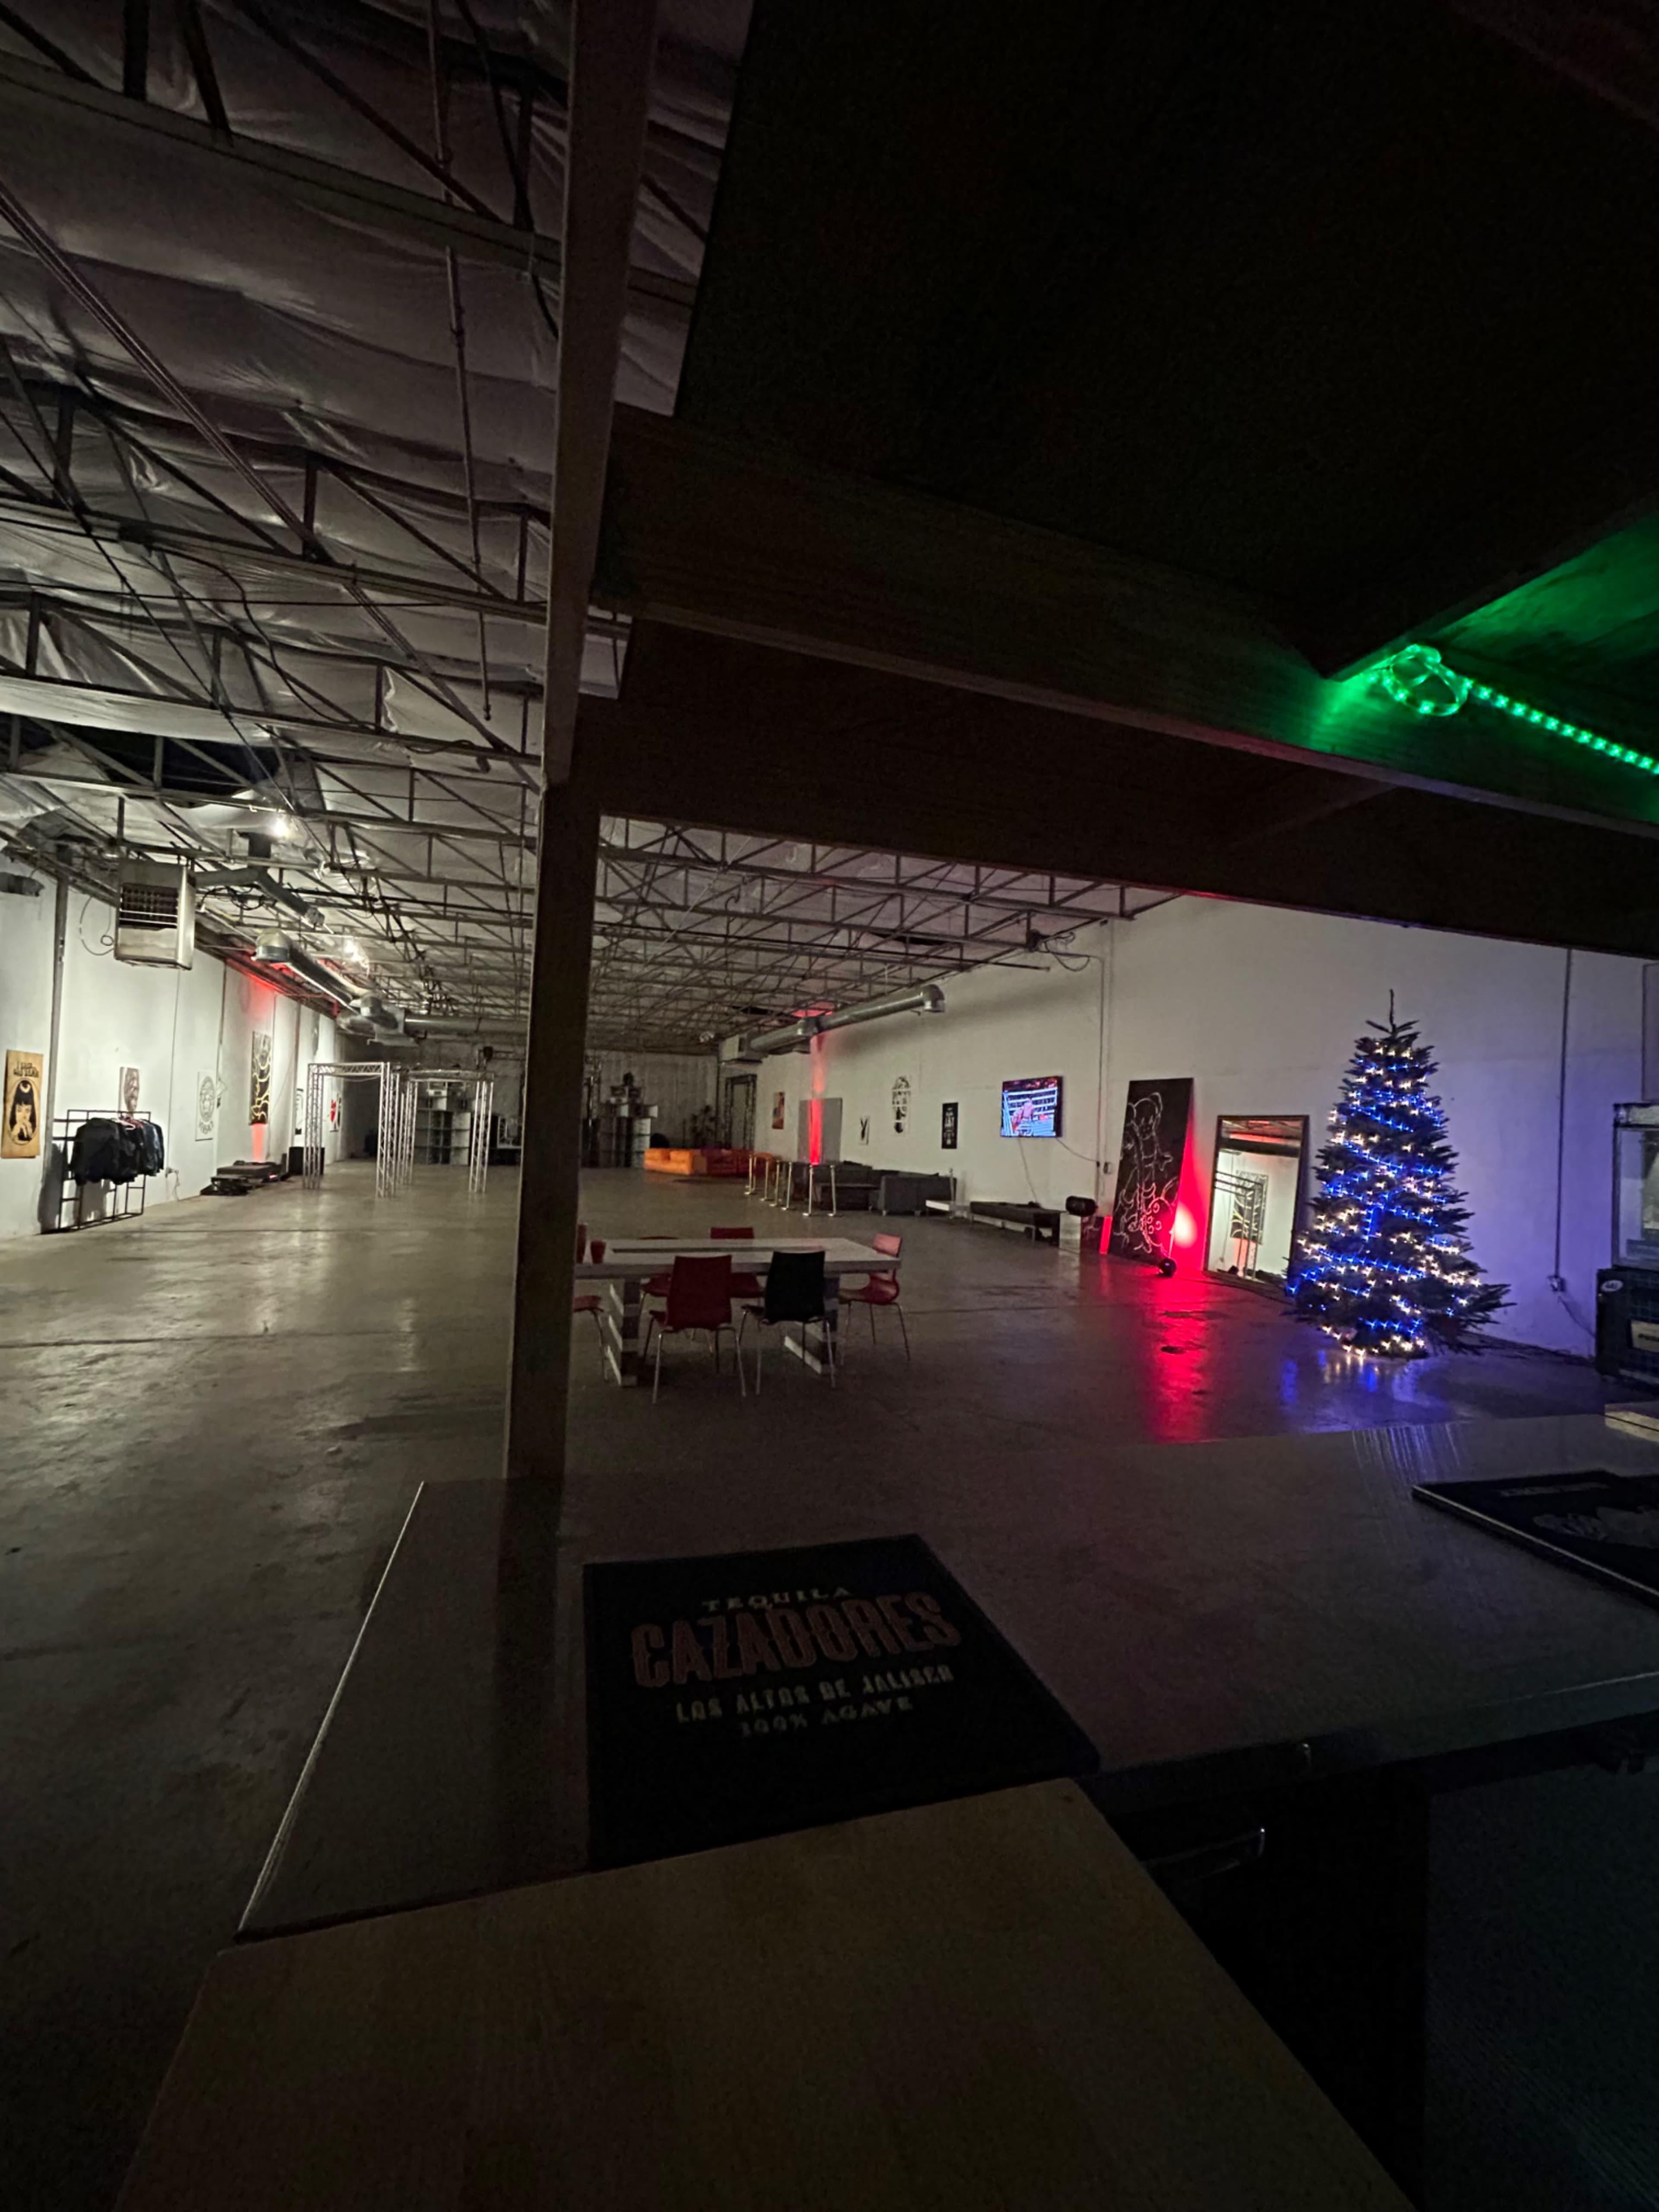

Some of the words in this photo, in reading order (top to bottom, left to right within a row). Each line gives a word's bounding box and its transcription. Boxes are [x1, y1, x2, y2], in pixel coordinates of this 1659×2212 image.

[702, 1586, 854, 1611] TEQUILA
[631, 1592, 962, 1687] CAZADORES
[675, 1697, 723, 1724] LOS
[736, 1684, 810, 1715] ALTOS
[819, 1676, 852, 1701] DE
[862, 1663, 955, 1694] JALISCO
[736, 1713, 809, 1738] 100%
[821, 1695, 914, 1725] AGAVE
